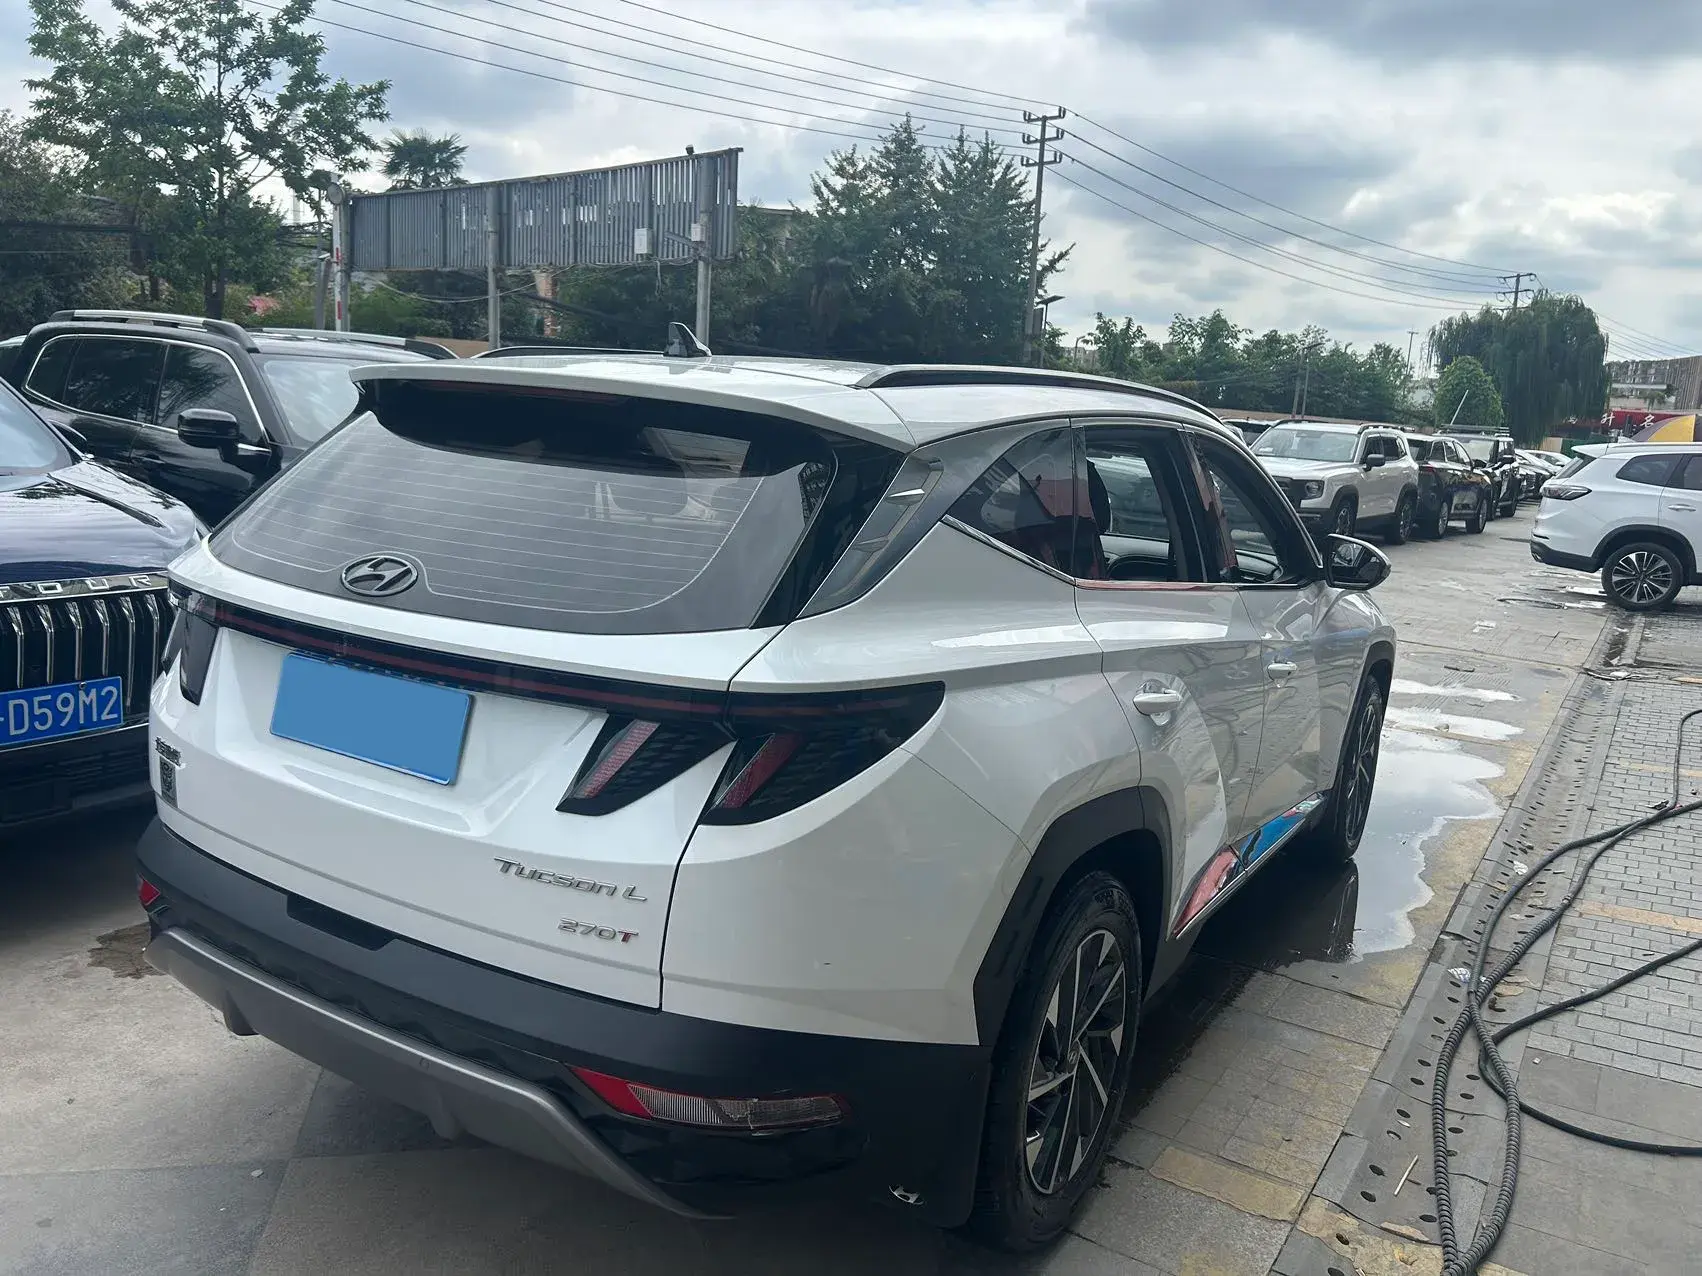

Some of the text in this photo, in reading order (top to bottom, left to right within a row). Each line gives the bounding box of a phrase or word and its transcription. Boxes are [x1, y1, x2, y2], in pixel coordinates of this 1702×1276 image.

[8, 686, 118, 736] D59M2
[621, 885, 648, 902] L
[557, 917, 639, 943] 270T
